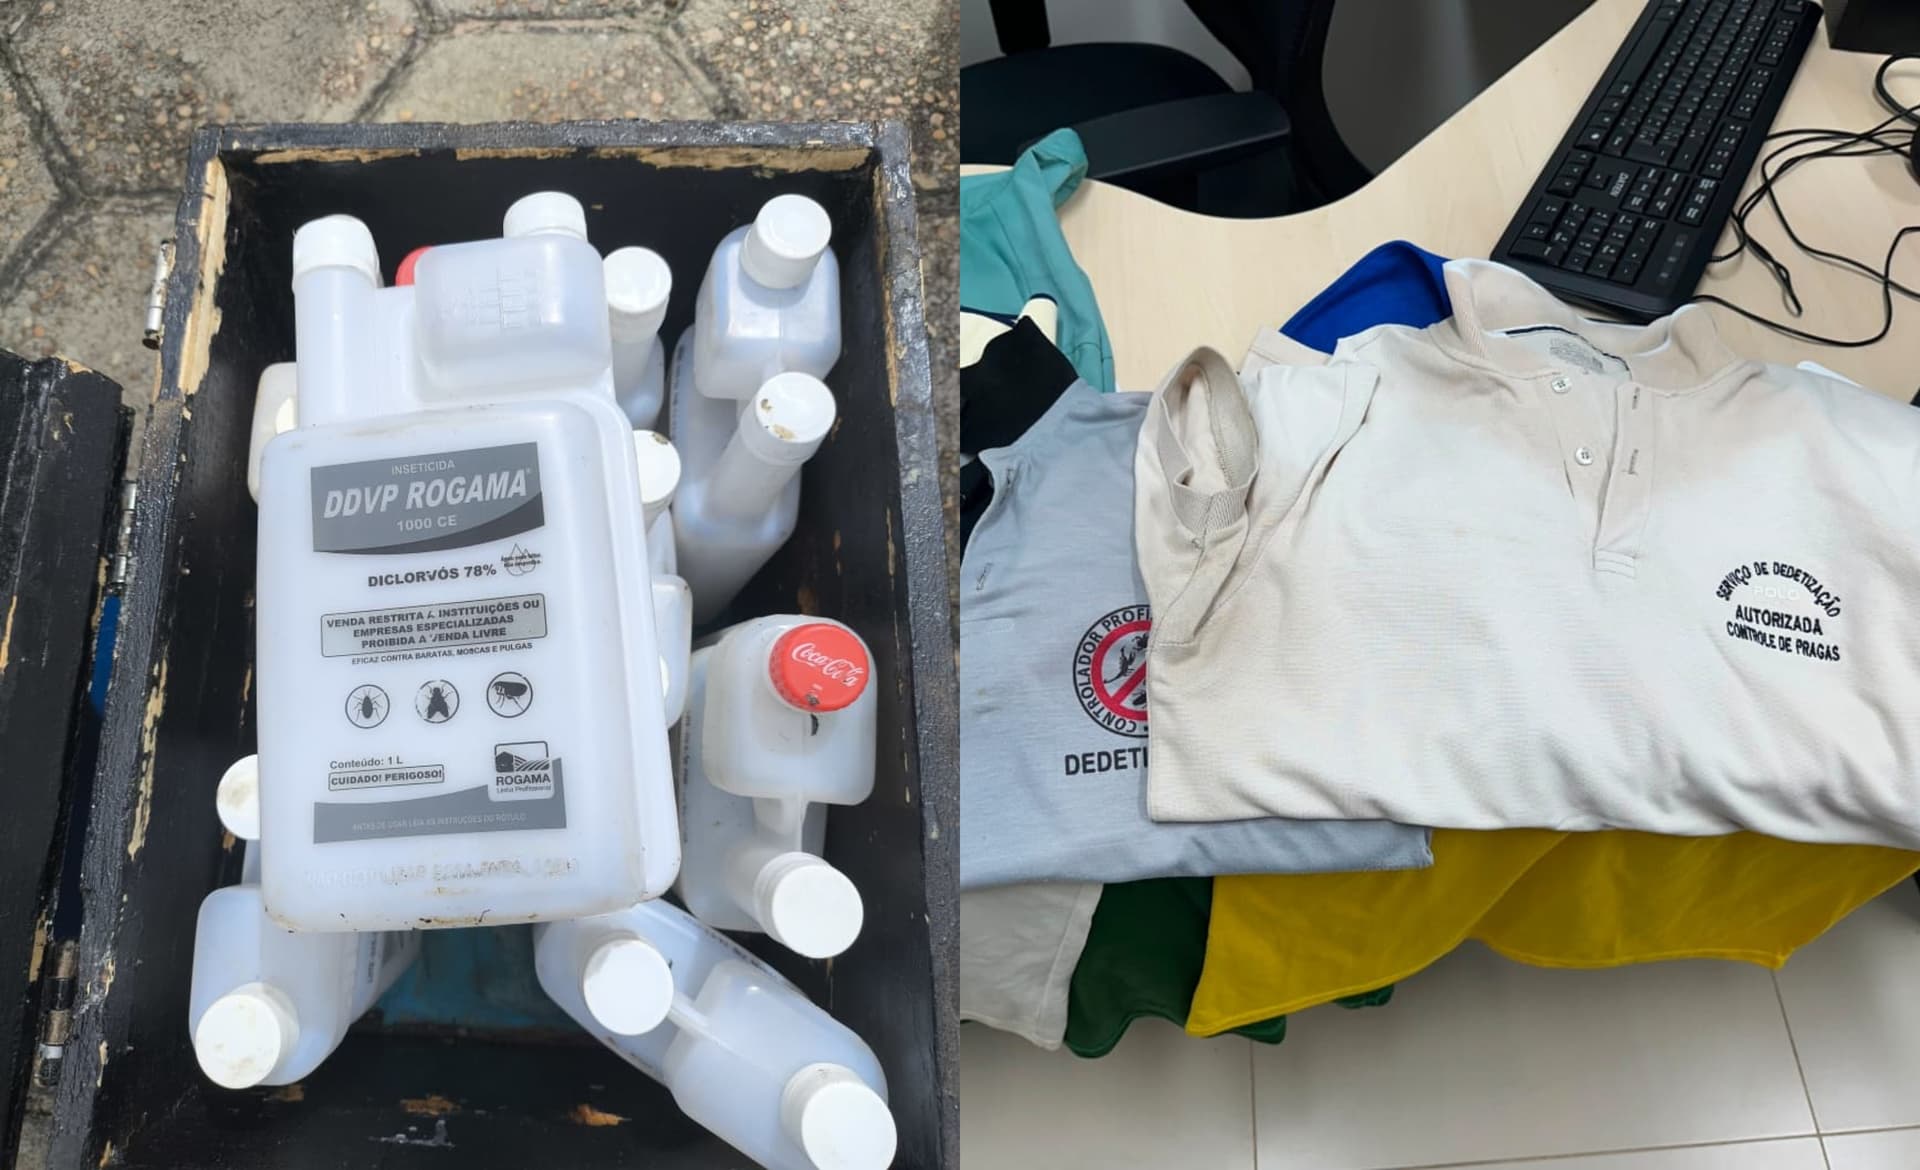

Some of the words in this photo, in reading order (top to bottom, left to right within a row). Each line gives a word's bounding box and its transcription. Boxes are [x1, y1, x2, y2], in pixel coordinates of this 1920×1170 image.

[391, 459, 456, 475] INSETICIDA
[323, 484, 399, 518] DDVP
[396, 516, 432, 532] 1000
[437, 515, 457, 528] CE
[368, 567, 460, 587] DICLORVÓS
[464, 564, 497, 578] 78%
[1715, 564, 1752, 602] SERVIÇO
[1753, 561, 1769, 576] DE
[1773, 561, 1841, 618] DEDETIZAÇÃO
[327, 617, 365, 628] VENDA
[368, 612, 424, 625] RESTRITA
[438, 602, 519, 618] INSTITUIÇÕES
[522, 599, 540, 609] OU
[1102, 607, 1152, 632] PROFI
[1735, 604, 1823, 636] AUTORIZADA
[353, 624, 413, 638] EMPRESAS
[416, 614, 514, 632] ESPECIALIZADAS
[362, 636, 416, 648] PROIBIDA
[472, 627, 507, 639] LIVRE
[1726, 621, 1777, 650] CONTROLE
[1778, 635, 1793, 653] DE
[1795, 638, 1841, 662] PRAGAS
[352, 656, 379, 665] EFICAZ
[381, 653, 413, 663] CONTRA
[456, 646, 490, 656] MOSCAS
[492, 645, 498, 653] E
[500, 643, 533, 652] PULGAS
[1077, 631, 1137, 734] CONTROLADOR
[329, 757, 385, 769] Conteúdo:
[387, 756, 393, 765] 1
[396, 755, 404, 765] L
[331, 774, 382, 786] CUIDADO!
[384, 769, 442, 782] PERIGOSO!
[496, 773, 551, 786] ROGAMA
